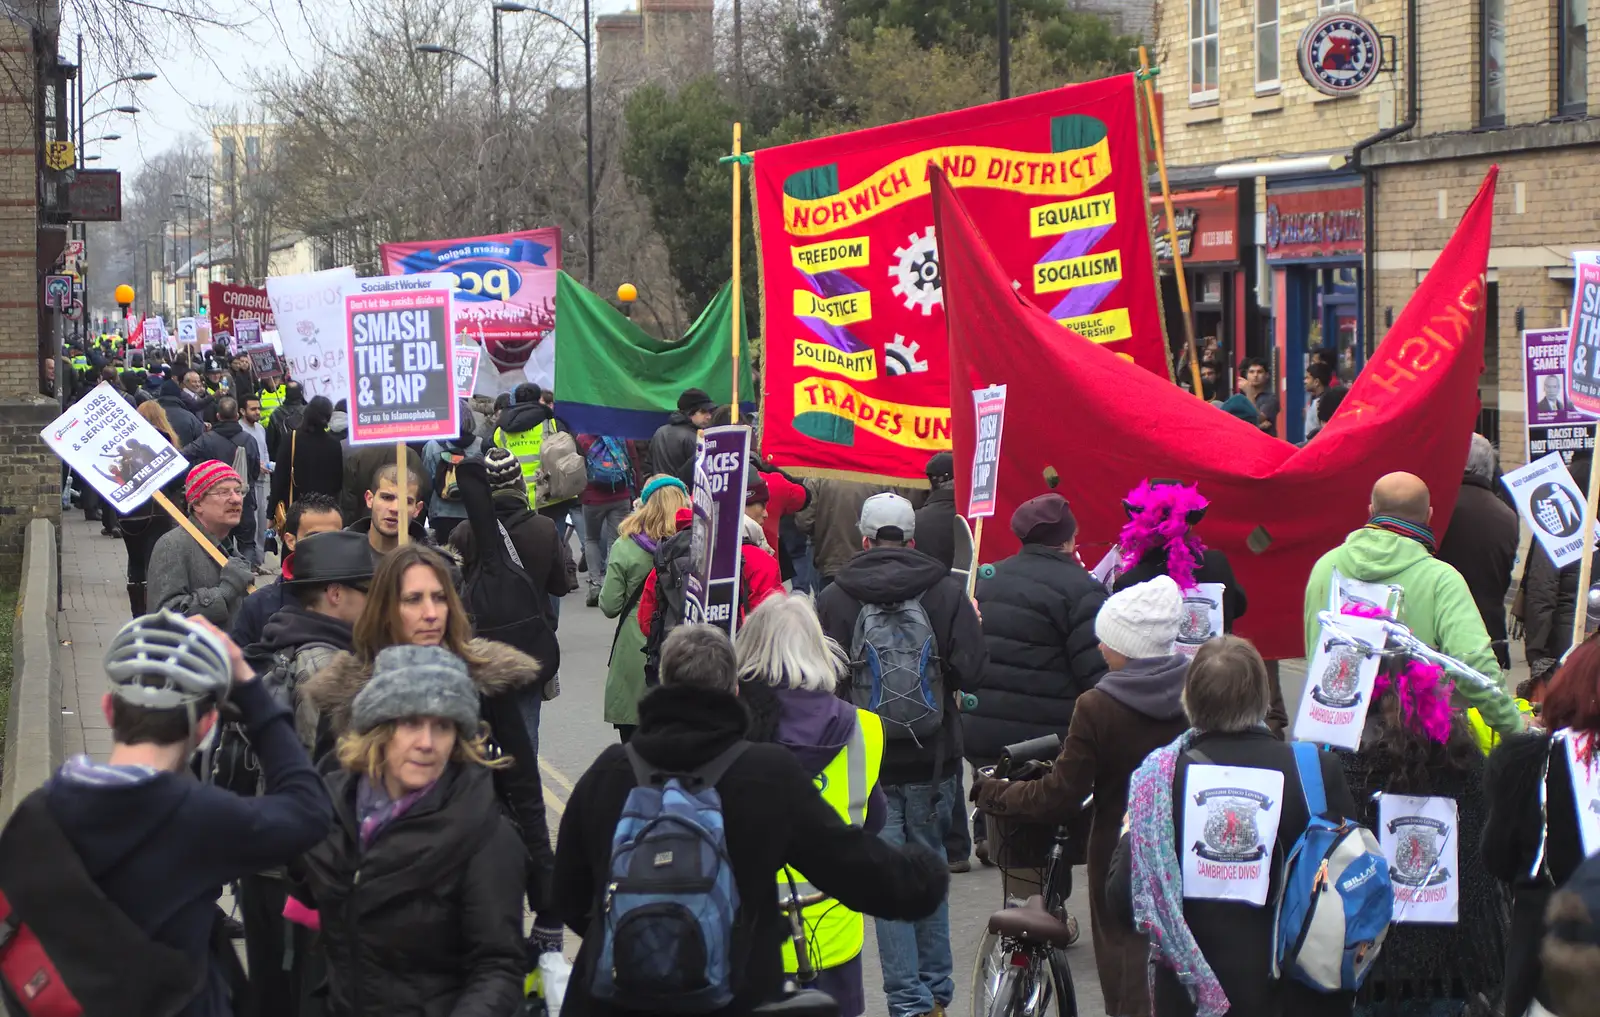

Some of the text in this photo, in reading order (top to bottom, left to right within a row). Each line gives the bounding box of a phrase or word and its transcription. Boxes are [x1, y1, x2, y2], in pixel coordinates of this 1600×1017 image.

[1313, 22, 1372, 48] CHICKEN
[1313, 62, 1373, 87] COTTAGE
[793, 153, 1097, 228] NORWICH AND DISTRICT
[1038, 198, 1111, 227] EQUALITY
[799, 243, 862, 265] FREEDOM
[1038, 256, 1118, 284] SOCIALISM
[361, 279, 432, 292] Socialist Worker
[350, 299, 367, 309] Don't
[379, 298, 390, 307] the
[416, 295, 434, 305] divide
[810, 297, 858, 318] JUSTICE
[353, 310, 430, 343] SMASH
[1066, 319, 1103, 330] PUBLIC
[1079, 325, 1116, 338] ERSHIP
[354, 341, 444, 374] THE EDL
[796, 343, 874, 372] SOLIDARITY
[1533, 357, 1559, 371] SAME
[1573, 345, 1587, 375] &
[358, 373, 427, 406] & BNP
[84, 393, 111, 415] JOBS,
[84, 399, 117, 427] HOMES
[804, 384, 952, 440] TRADES UN
[111, 413, 131, 432] NOT
[359, 413, 371, 423] Say
[383, 412, 389, 420] to
[391, 409, 435, 420] Islamophobia
[72, 406, 124, 451] & SERVICES
[101, 422, 140, 453] RACISM!
[1547, 427, 1589, 439] RACIST EDL
[704, 439, 717, 449] ism
[1531, 440, 1547, 451] NOT
[1547, 438, 1583, 450] WELCOME
[112, 450, 171, 500] STOP THE EDL!
[1197, 860, 1237, 880] CAMBRIDGE
[1424, 885, 1448, 903] DIVISION
